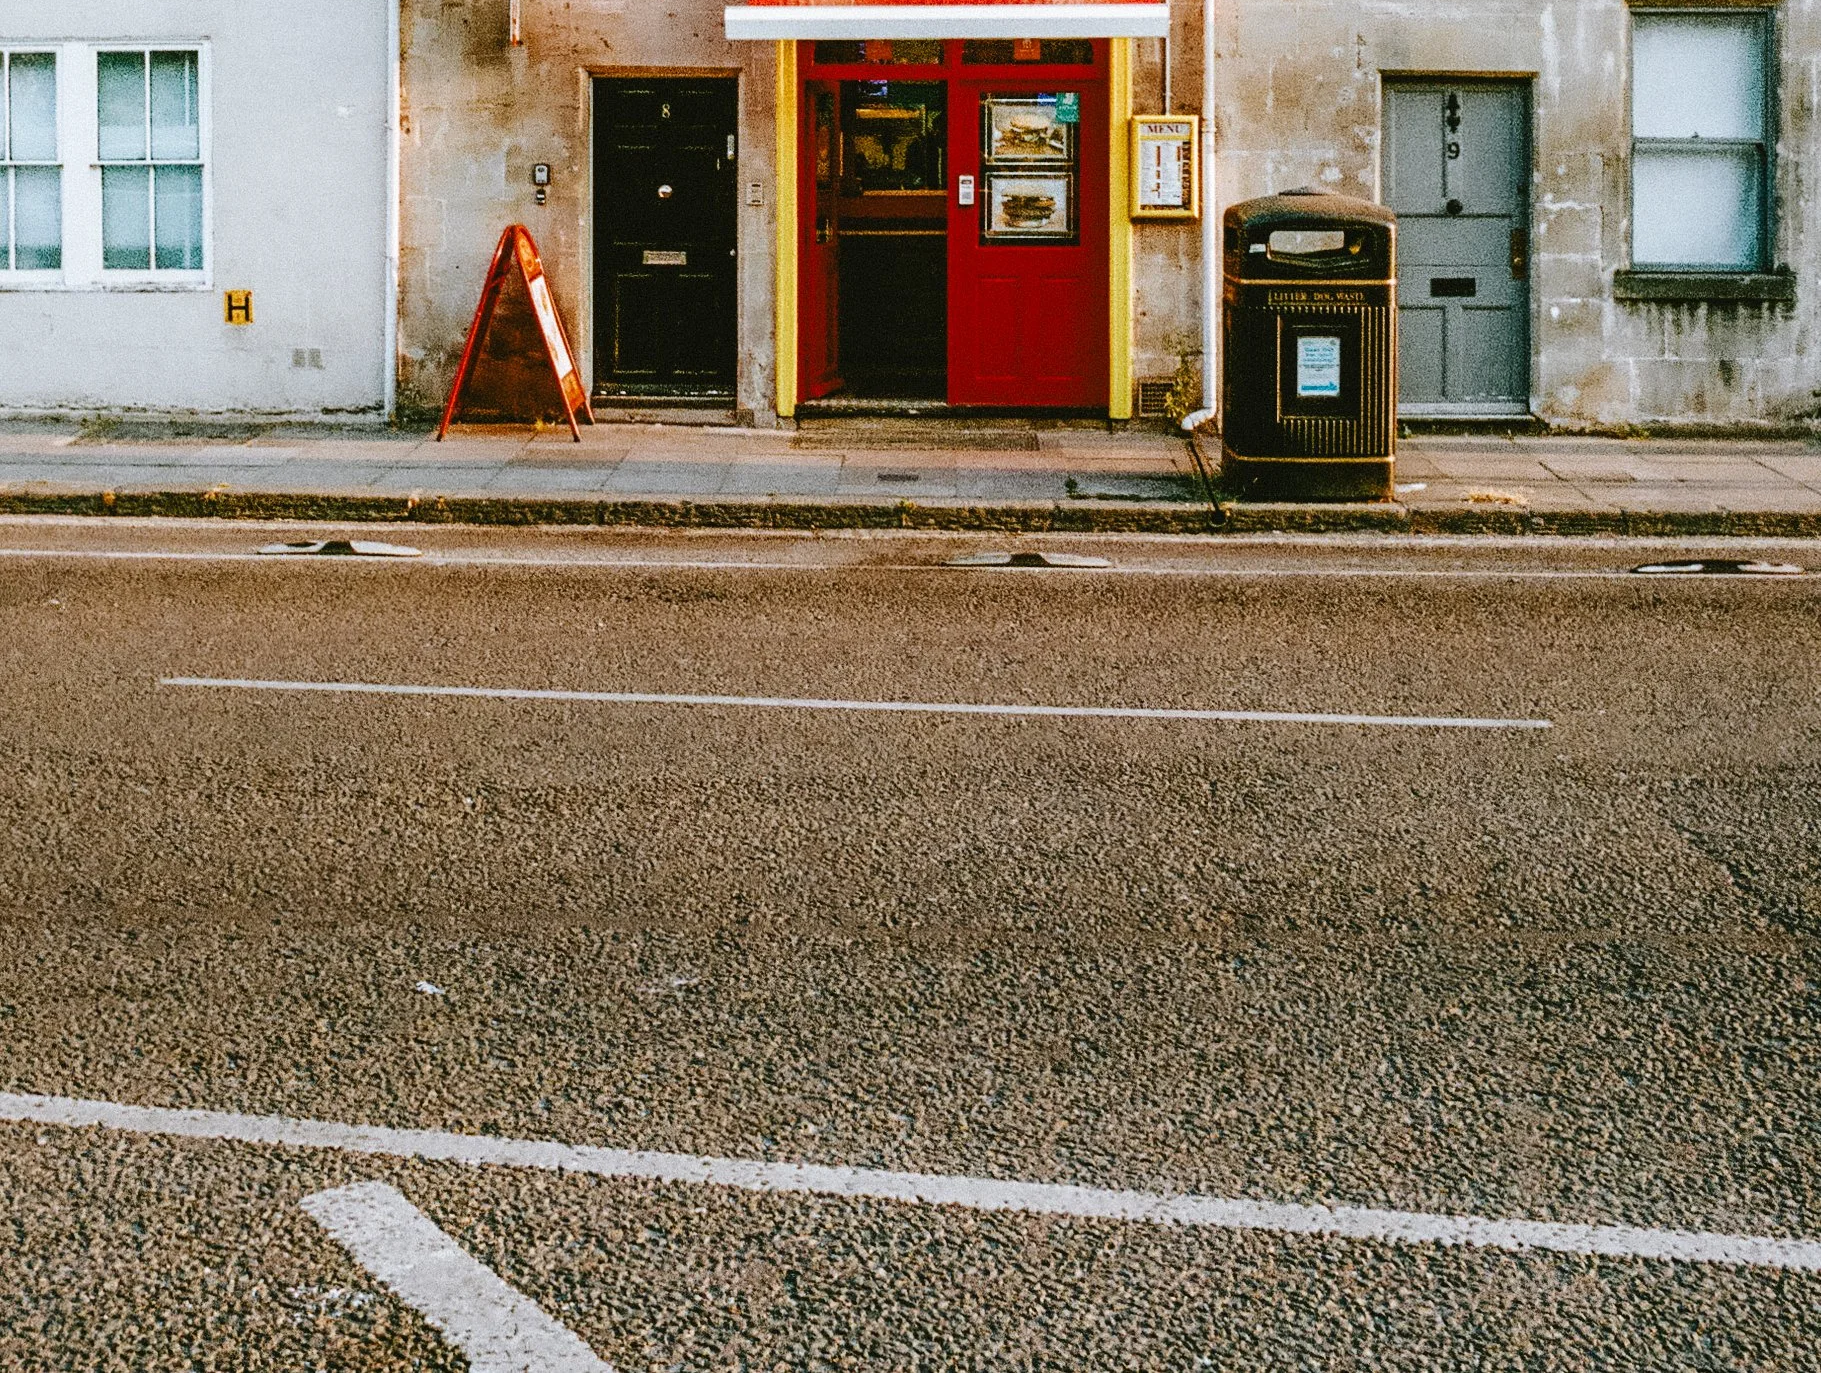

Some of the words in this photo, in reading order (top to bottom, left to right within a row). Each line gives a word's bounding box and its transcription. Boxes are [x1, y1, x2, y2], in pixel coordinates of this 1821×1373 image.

[662, 103, 671, 118] 8
[1147, 125, 1182, 134] MENU
[1447, 141, 1460, 160] 9
[227, 293, 250, 322] H
